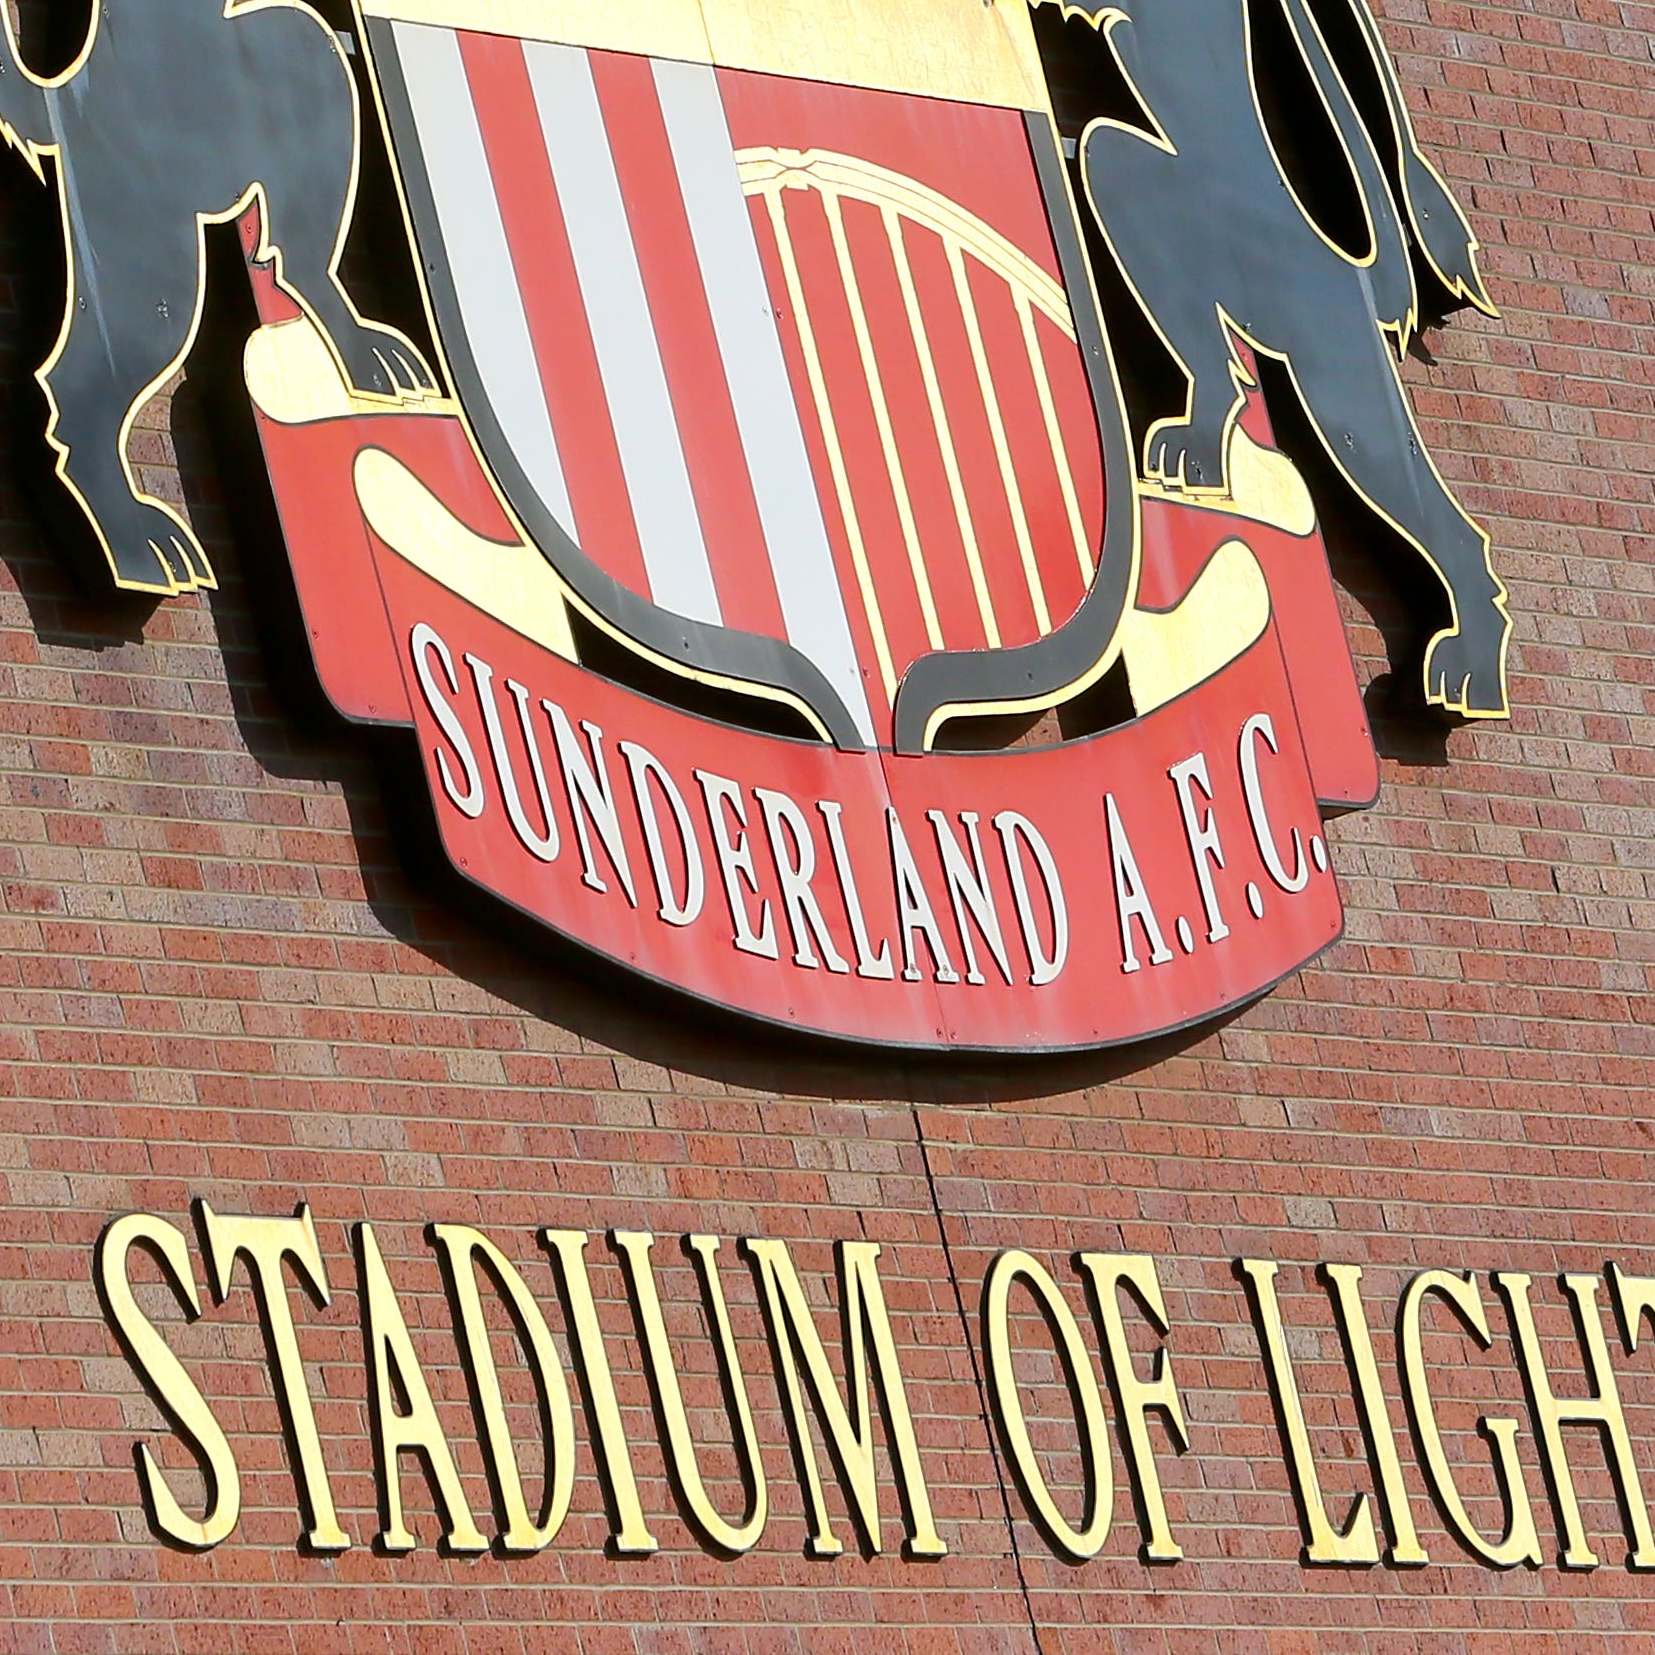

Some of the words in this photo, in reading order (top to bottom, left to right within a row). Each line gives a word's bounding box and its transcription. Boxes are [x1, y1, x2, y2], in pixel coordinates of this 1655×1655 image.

[410, 621, 1069, 987] SUNDERLAND
[1106, 711, 1329, 974] A.F.C.
[95, 1198, 949, 1559] STADIUM
[981, 1247, 1190, 1566] OF
